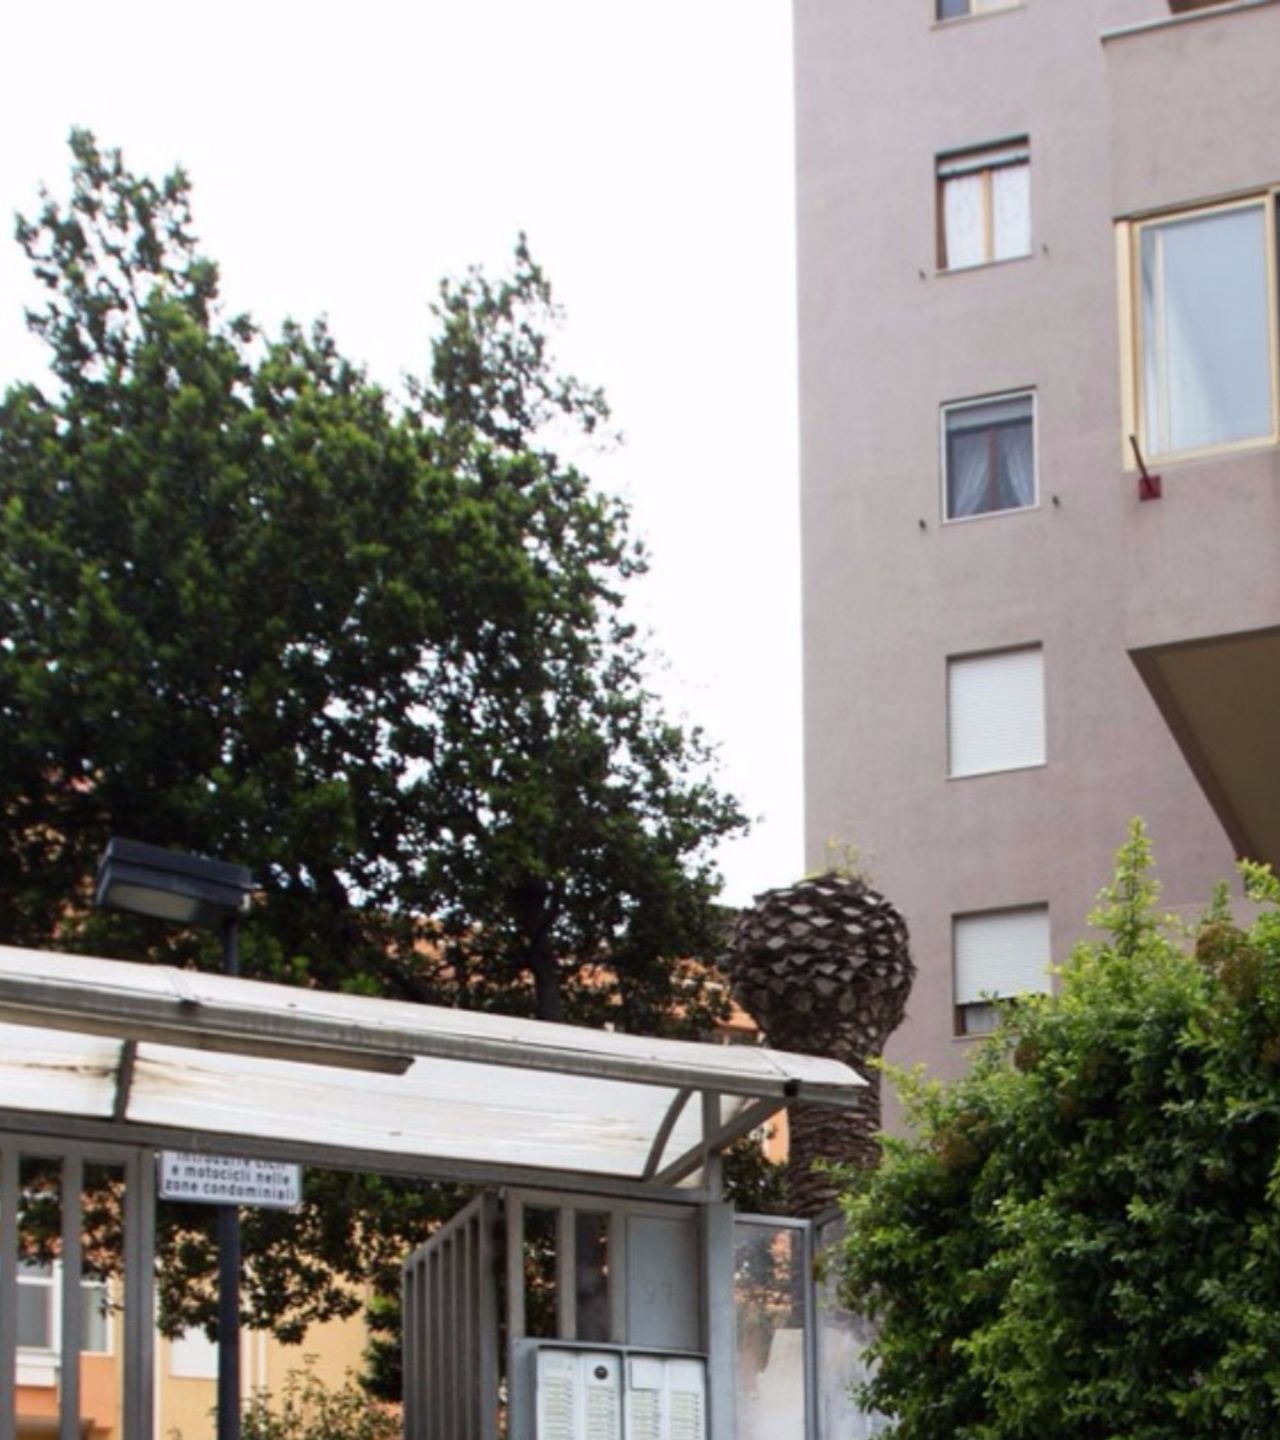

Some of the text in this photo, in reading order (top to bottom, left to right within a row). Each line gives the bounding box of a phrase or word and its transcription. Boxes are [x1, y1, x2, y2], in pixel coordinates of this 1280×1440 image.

[184, 1165, 252, 1183] motocicli
[256, 1170, 290, 1187] nelle
[165, 1178, 296, 1201] zone condominiali
